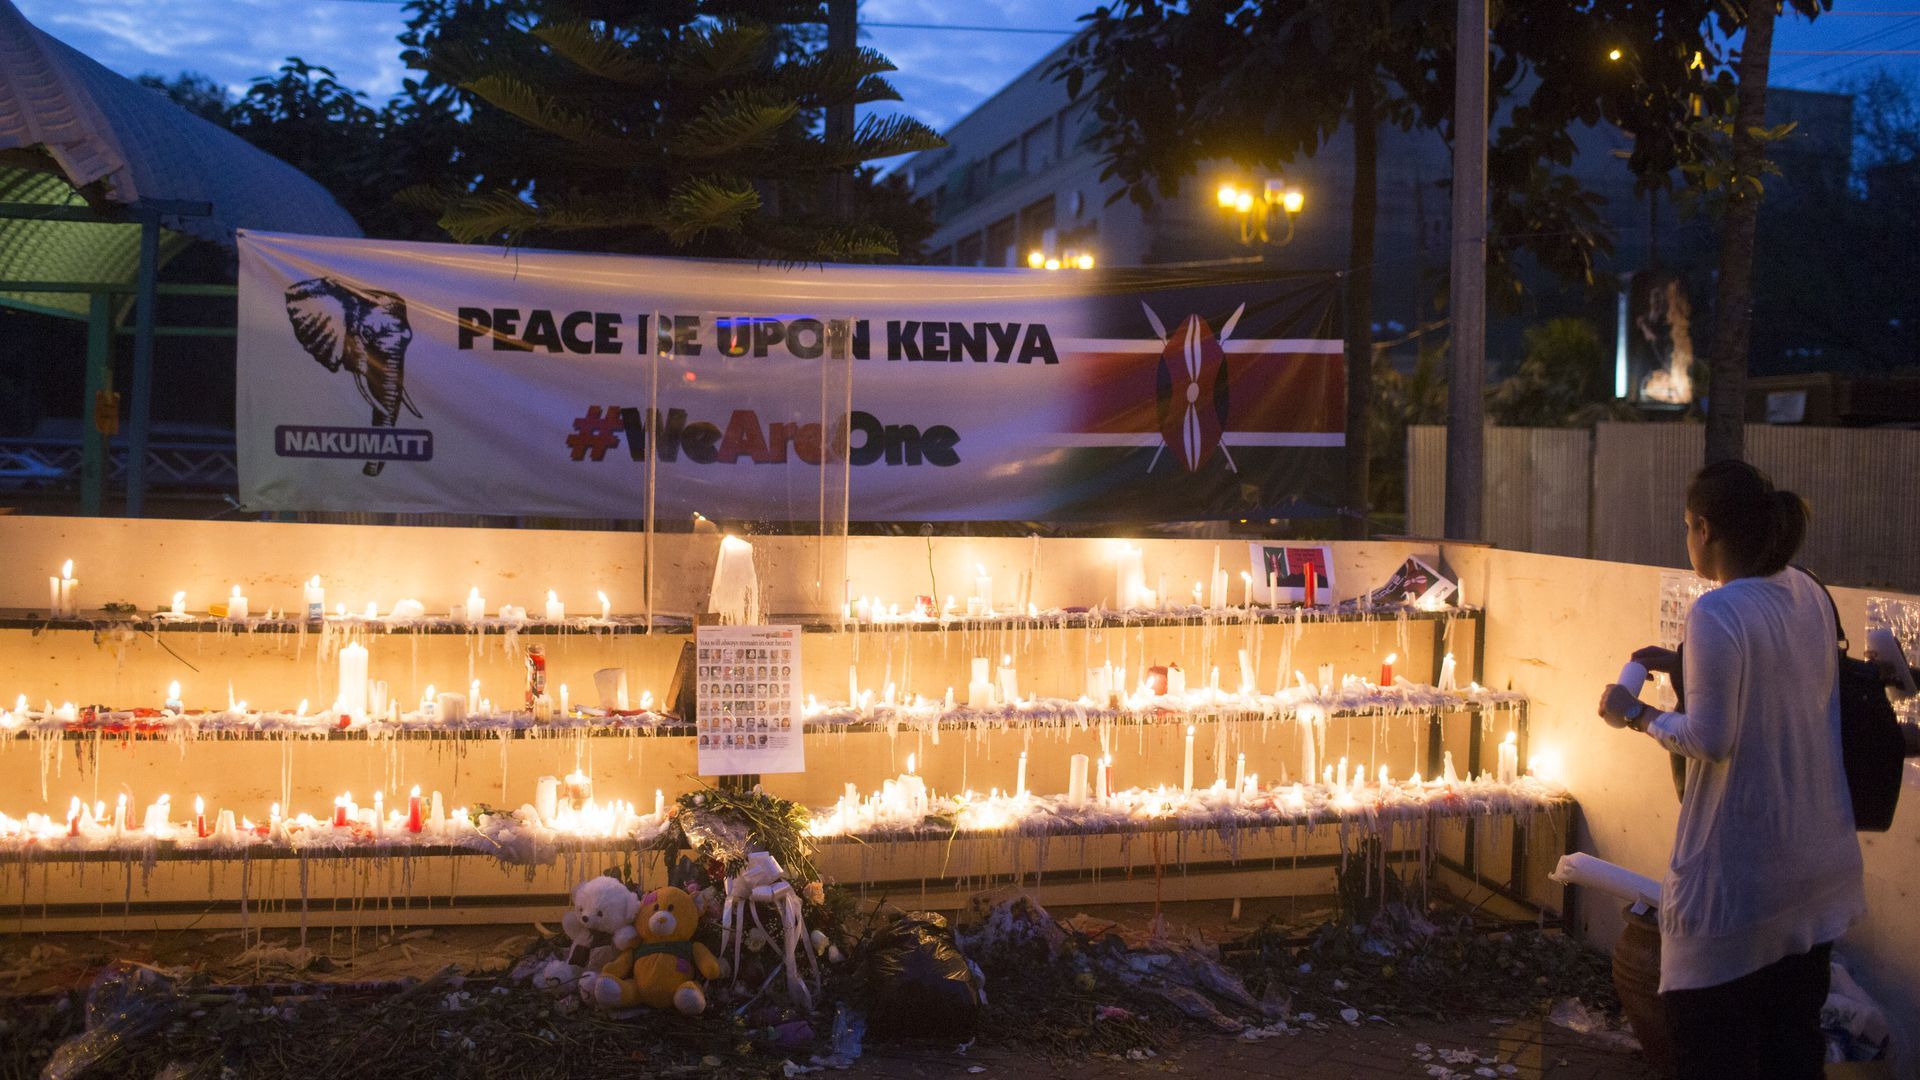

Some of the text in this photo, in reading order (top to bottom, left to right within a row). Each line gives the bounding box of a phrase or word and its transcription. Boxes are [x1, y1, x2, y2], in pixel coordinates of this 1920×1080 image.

[458, 307, 1060, 365] PEACE BE UPON KENYA
[284, 430, 429, 455] NAKUMATT
[565, 405, 961, 467] #WeAreOne
